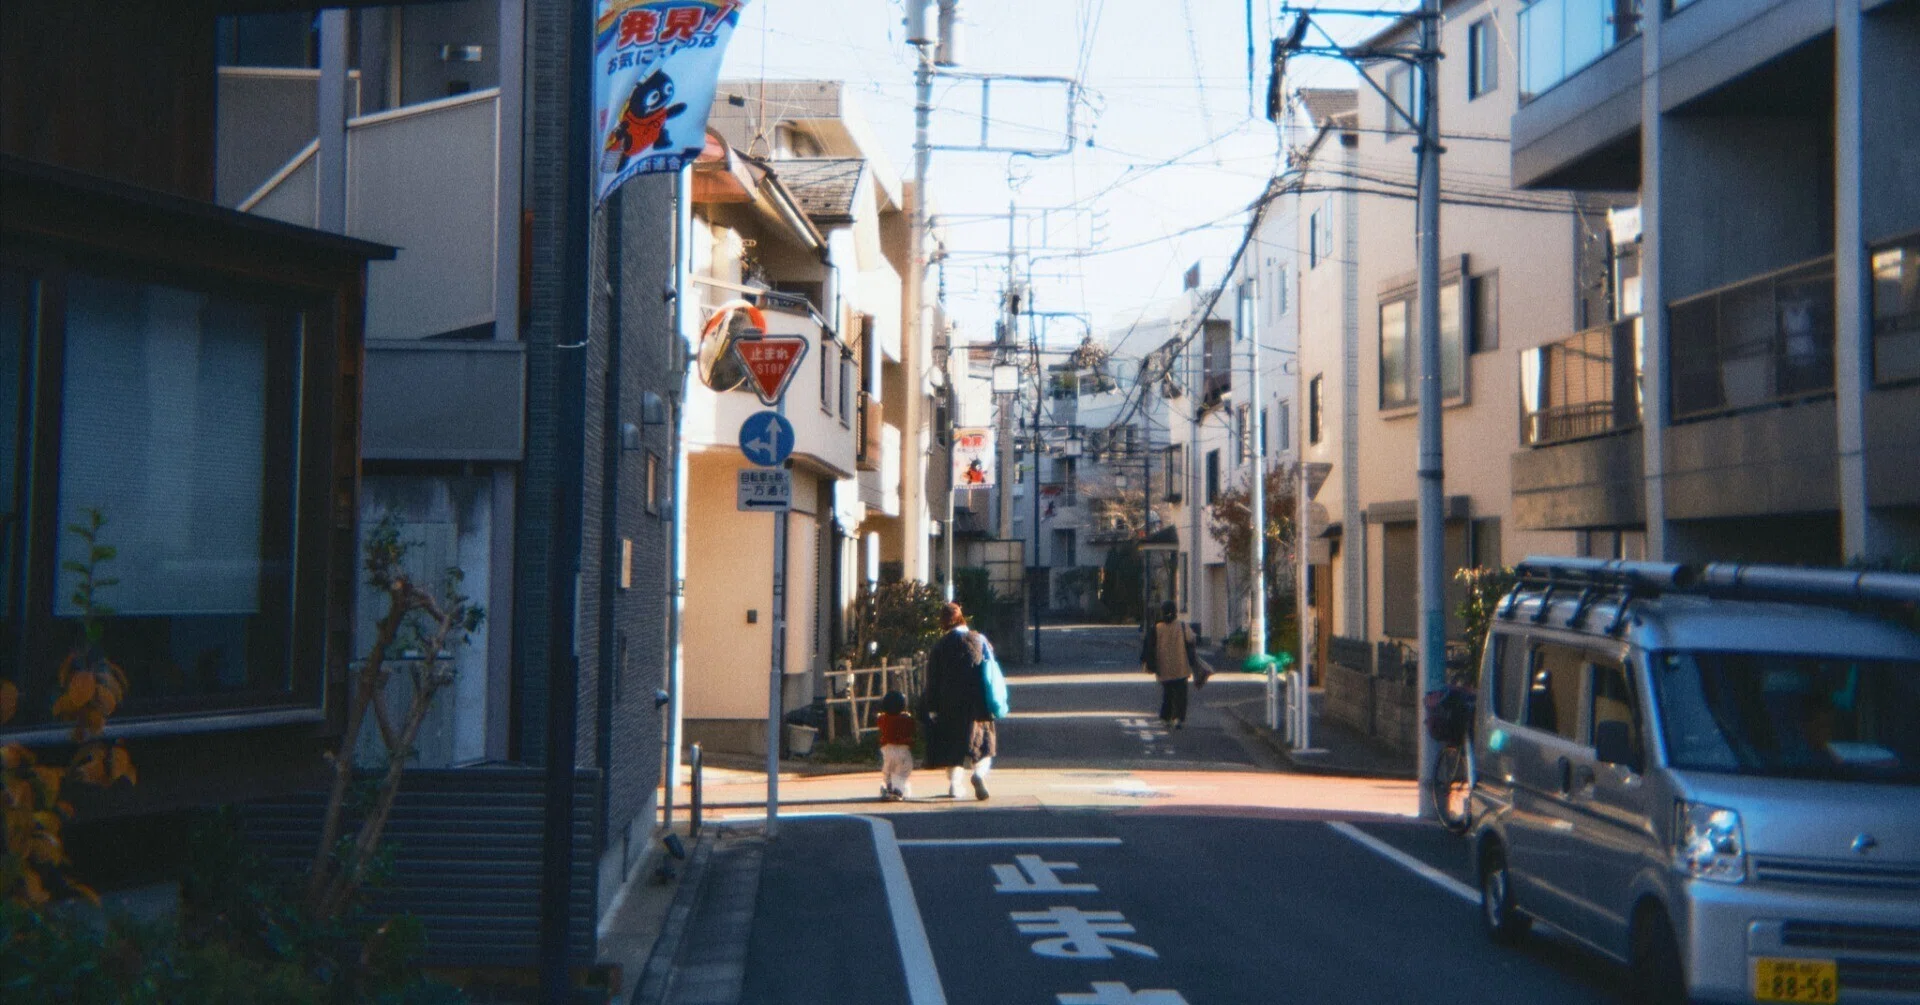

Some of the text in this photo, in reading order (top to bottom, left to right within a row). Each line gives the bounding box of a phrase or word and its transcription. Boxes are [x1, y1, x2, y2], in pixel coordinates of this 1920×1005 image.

[617, 2, 737, 50] 発見!
[749, 346, 789, 360] 止まれ
[756, 363, 784, 374] STOP
[741, 485, 789, 496] 一方通行
